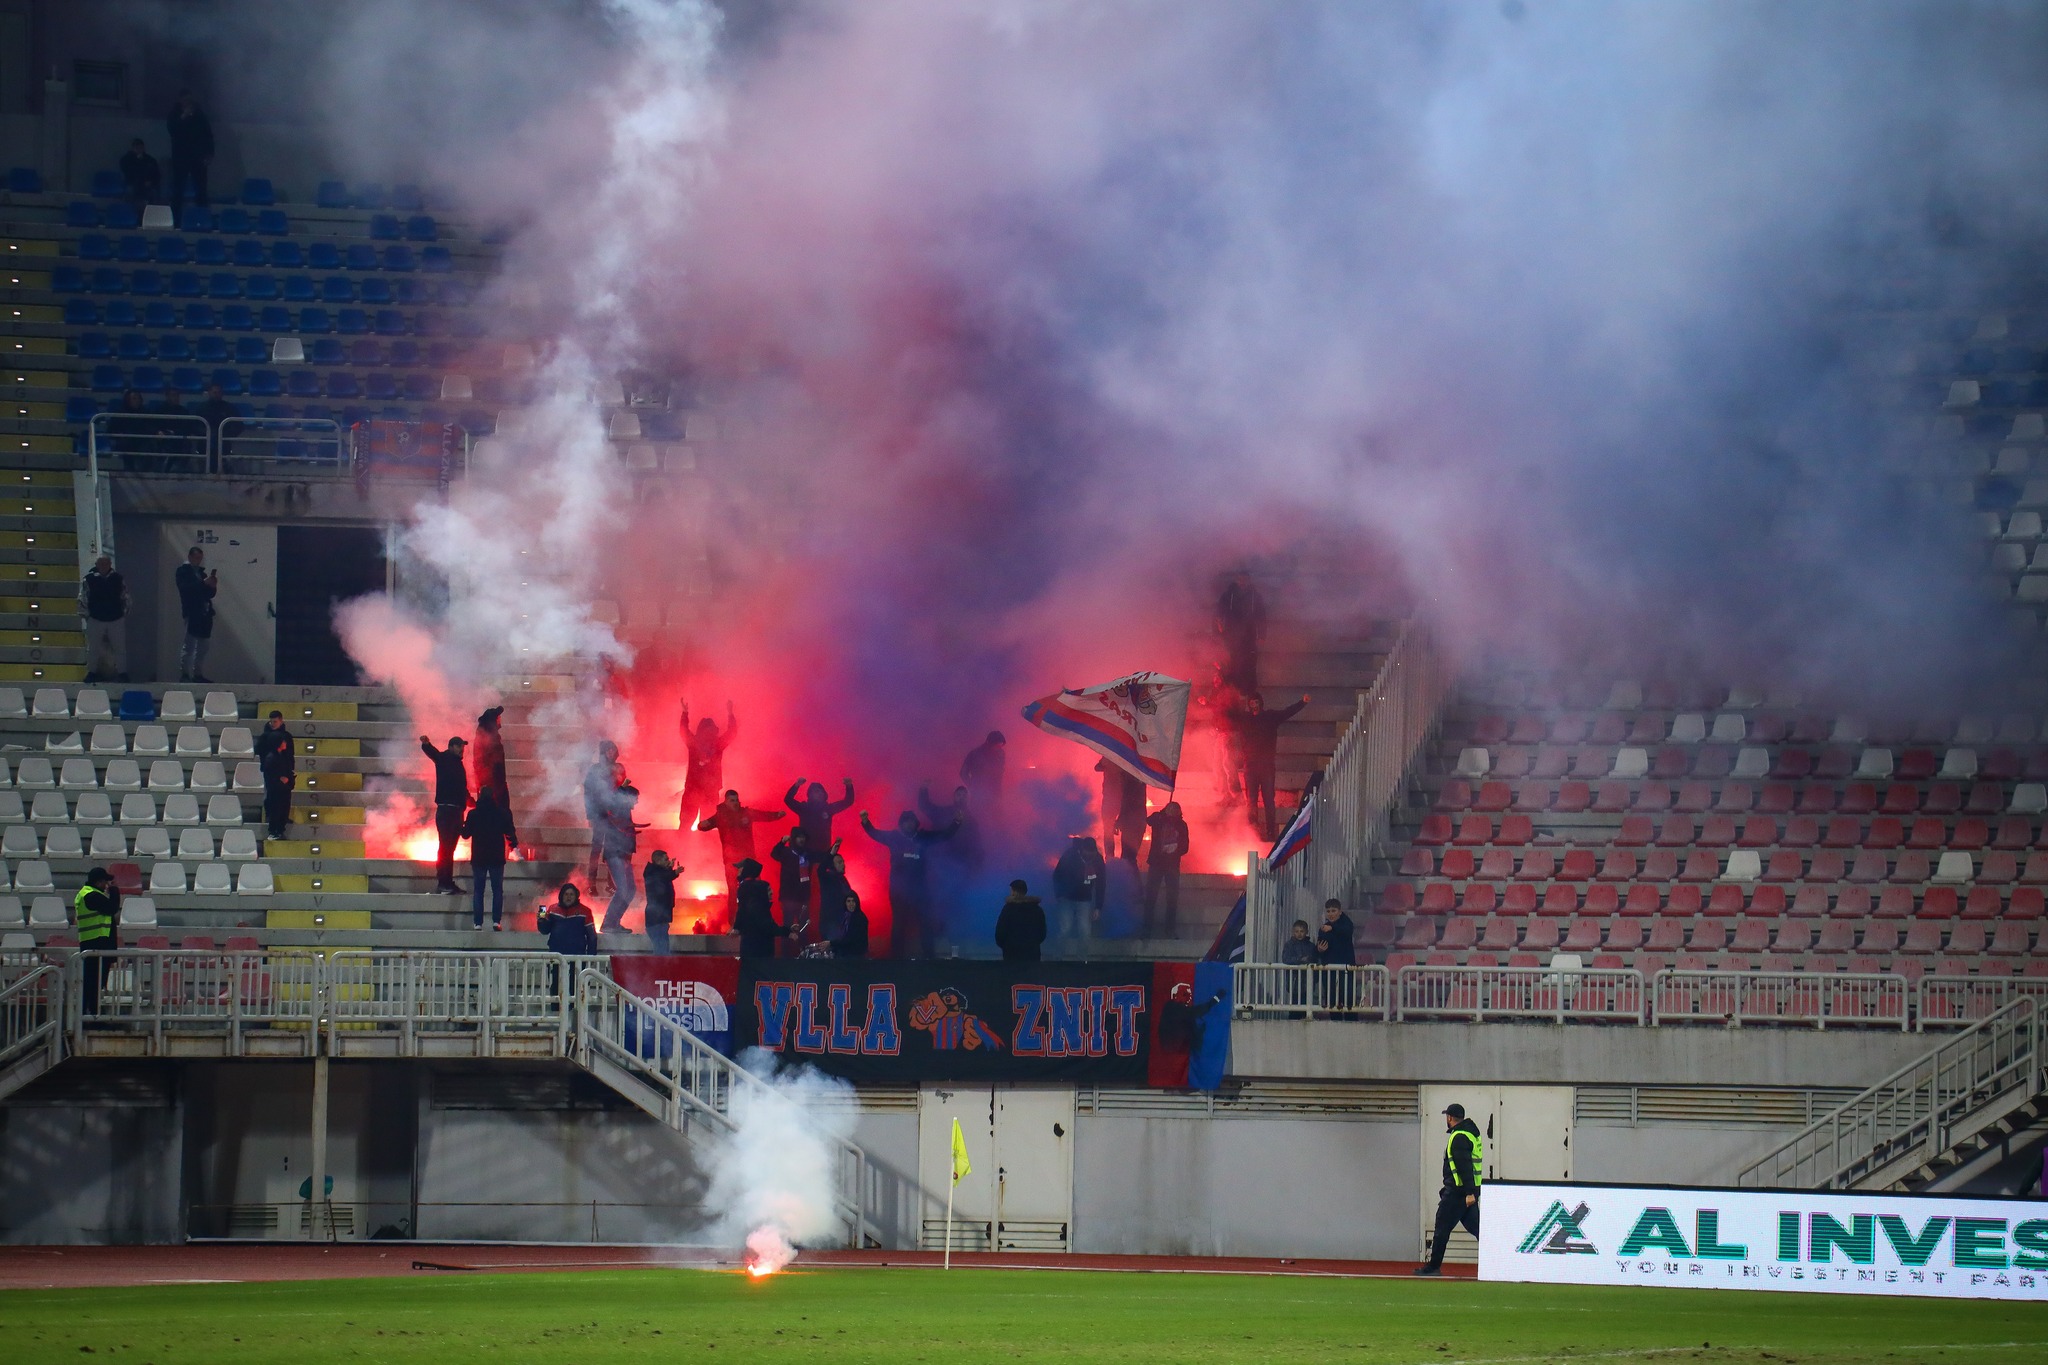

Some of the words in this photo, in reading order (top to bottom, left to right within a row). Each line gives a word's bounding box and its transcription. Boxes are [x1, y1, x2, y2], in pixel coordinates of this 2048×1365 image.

[15, 387, 26, 399] G
[17, 419, 29, 431] H
[22, 488, 31, 499] J
[22, 518, 32, 529] K
[25, 549, 36, 562] L
[25, 582, 39, 594] M
[27, 616, 39, 628] N
[30, 648, 42, 661] O
[301, 687, 312, 699] P
[304, 723, 316, 735] Q
[305, 758, 317, 771] R
[309, 825, 320, 836] T
[312, 860, 322, 873] U
[313, 895, 324, 908] V
[314, 930, 325, 941] Y
[655, 980, 693, 997] THE
[628, 997, 693, 1014] ORTH
[754, 980, 901, 1056] VLLA
[1011, 984, 1146, 1057] ZNIT
[1616, 1206, 1748, 1260] AL
[1616, 1260, 1704, 1275] YOUR
[1727, 1264, 1948, 1283] INVESTMENT
